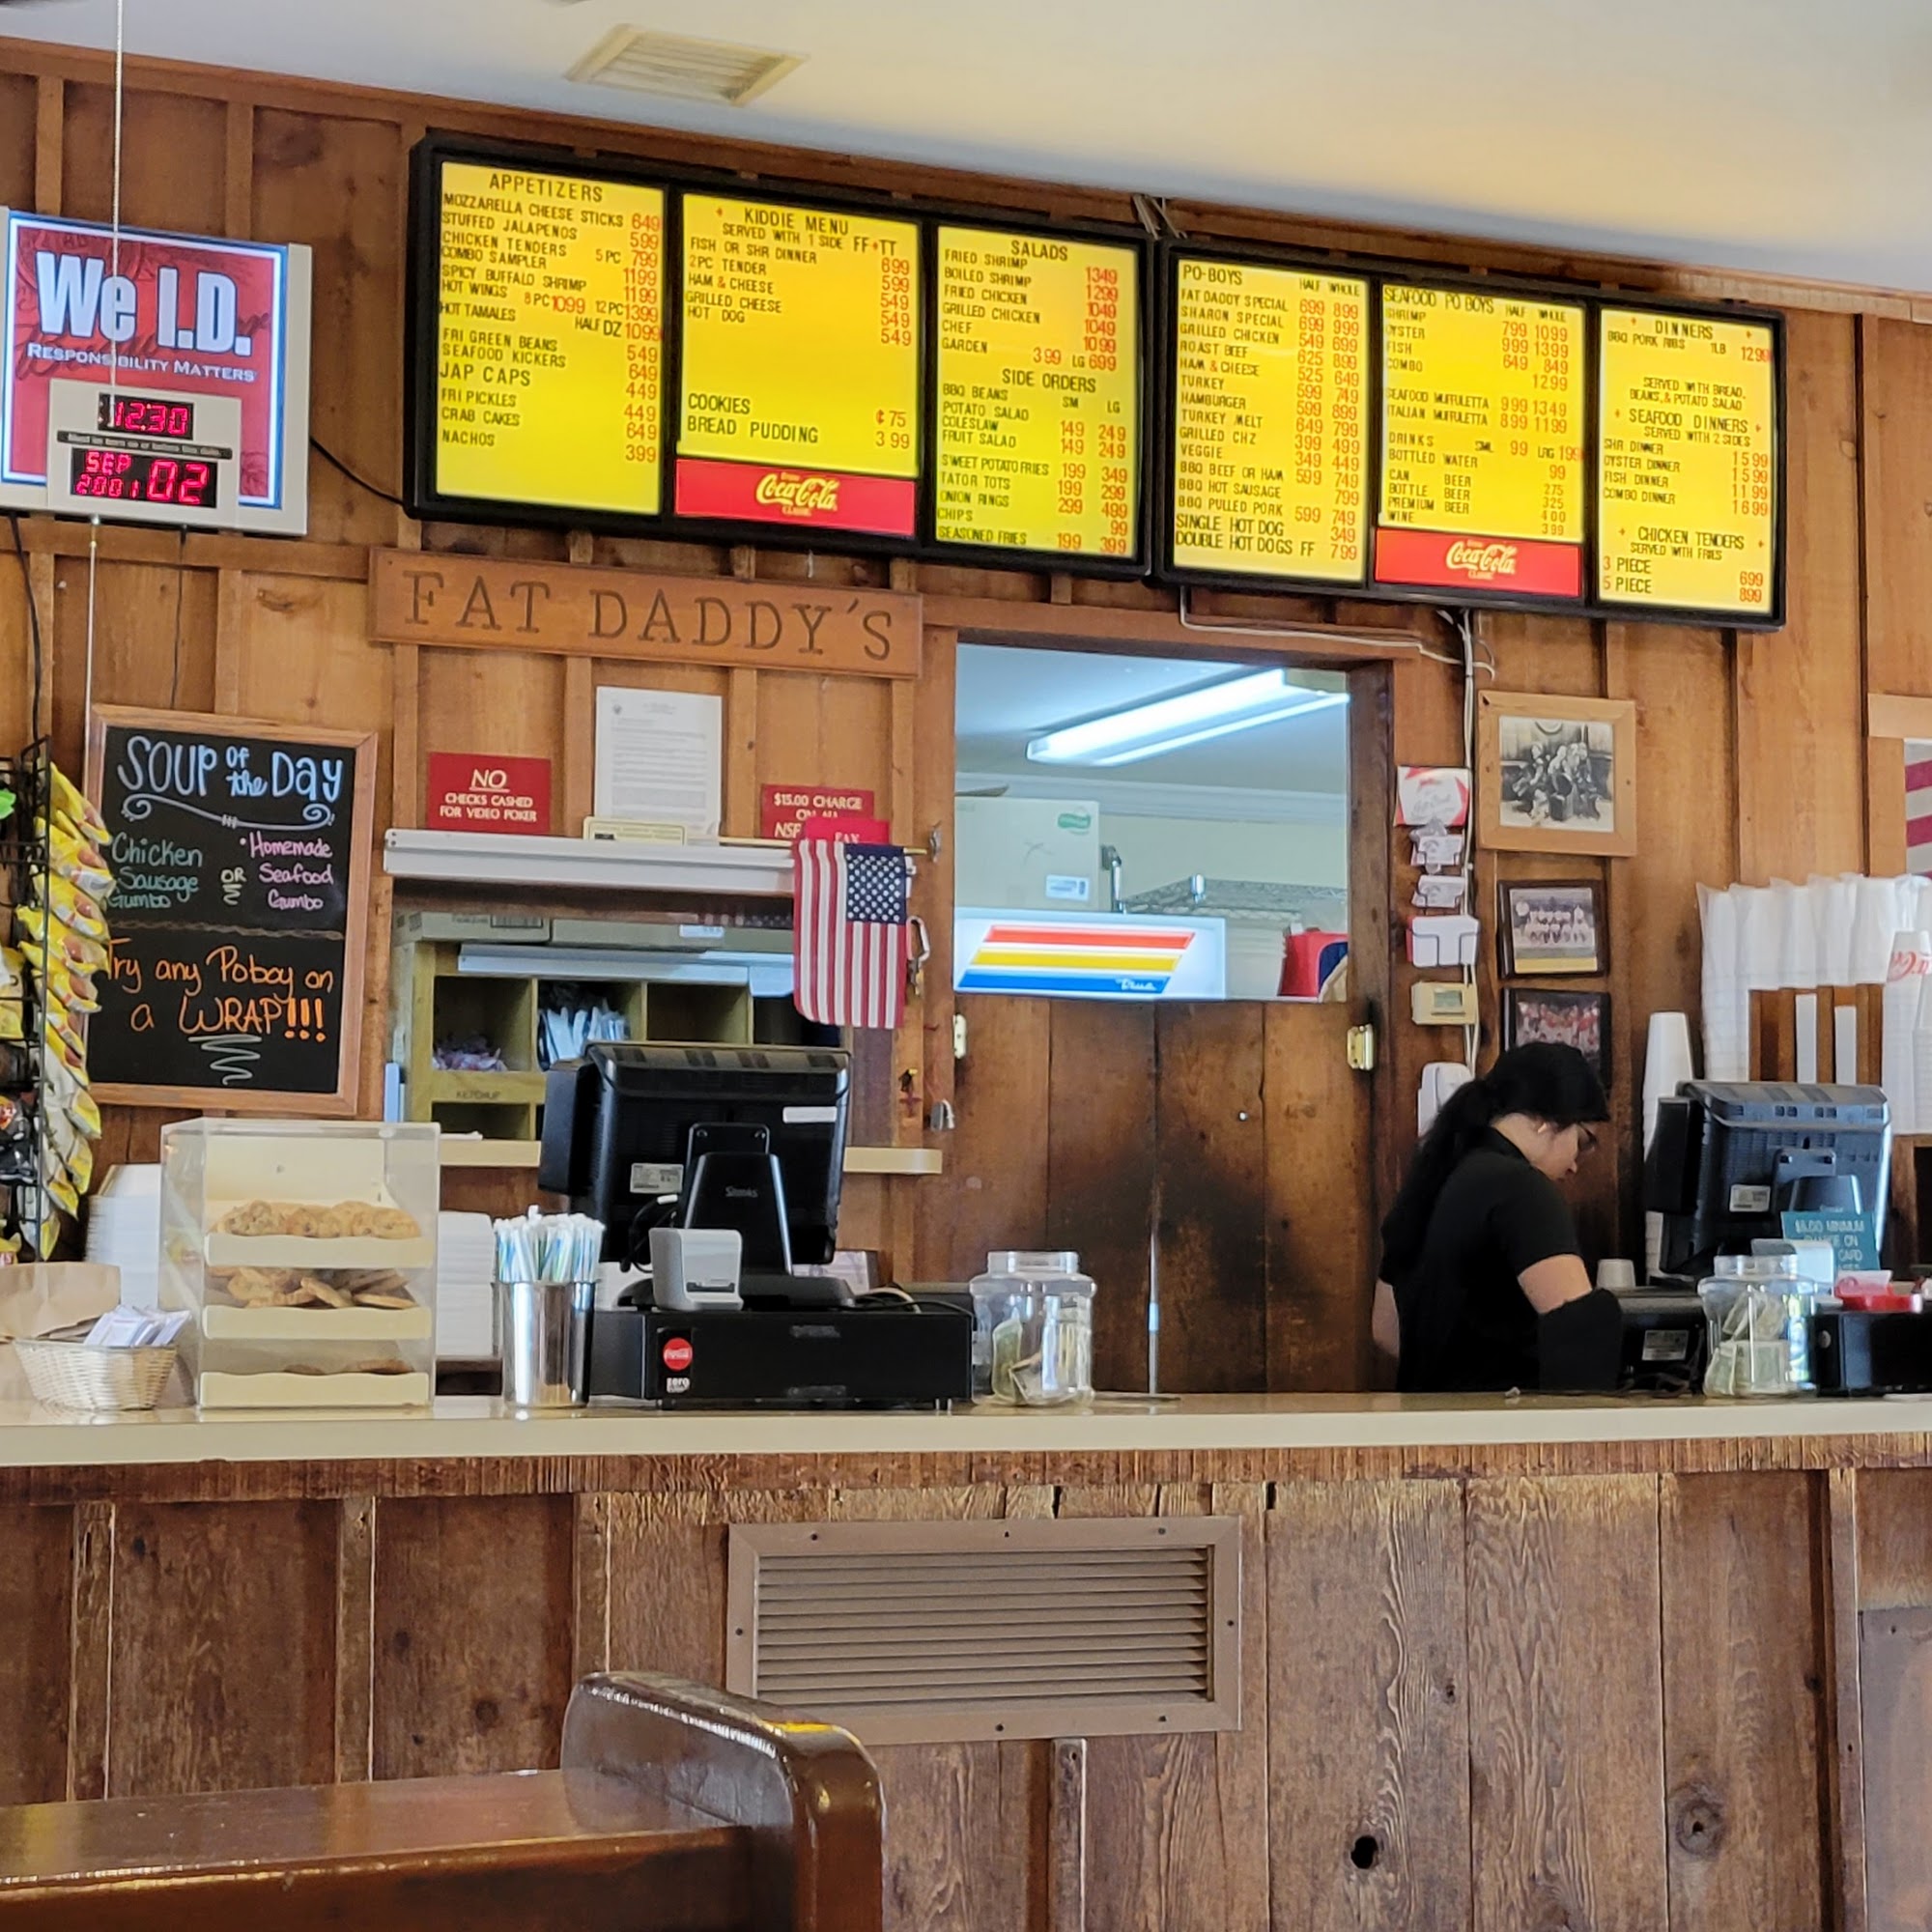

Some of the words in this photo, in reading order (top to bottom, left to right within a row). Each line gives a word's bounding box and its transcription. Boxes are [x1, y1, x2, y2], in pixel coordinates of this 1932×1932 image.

[490, 174, 603, 202] APPETIZERS
[442, 194, 522, 215] MOZZARELLA
[528, 204, 573, 221] CHEESE
[581, 211, 624, 227] STICKS
[632, 213, 660, 232] 649
[745, 208, 794, 229] KIDDIE
[806, 215, 848, 235] MENU
[442, 212, 495, 229] STUFFED
[503, 220, 578, 240] JALAPENOS
[630, 232, 659, 249] 599
[723, 223, 765, 240] SERVED
[773, 230, 800, 243] WITH
[819, 235, 842, 249] SIDE
[442, 231, 497, 248] CHICKEN
[507, 238, 567, 257] TENDERS
[691, 237, 716, 252] FISH
[776, 246, 816, 264] DINNER
[1011, 241, 1067, 261] SALADS
[442, 245, 482, 262] COMBO
[490, 252, 546, 270] SAMPLER
[945, 249, 977, 264] FRIED
[984, 254, 1028, 270] SHRIMP
[442, 265, 475, 279] SPICY
[486, 269, 534, 285] BUFFALO
[543, 276, 586, 292] SHRIMP
[688, 273, 713, 287] HAM
[729, 278, 774, 295] CHEESE
[723, 259, 766, 274] TENDER
[882, 275, 909, 293] 599
[945, 268, 983, 283] BOILED
[989, 272, 1032, 288] SHRIMP
[1183, 265, 1242, 285] PO-BOYS
[442, 279, 463, 294] HOT
[469, 283, 507, 298] WINGS
[36, 250, 137, 343] We
[156, 266, 252, 356] I.D.
[440, 300, 462, 316] HOT
[465, 303, 515, 321] TAMALES
[685, 291, 732, 307] GRILLED
[740, 297, 781, 314] CHEESE
[943, 302, 985, 318] GRILLED
[992, 307, 1040, 324] CHICKEN
[1181, 289, 1201, 300] FAT
[1204, 292, 1240, 305] DADDY
[1244, 296, 1289, 312] SPECIAL
[1299, 299, 1324, 315] 699
[688, 306, 709, 320] HOT
[722, 309, 745, 324] DOG
[881, 328, 911, 346] 549
[942, 320, 973, 334] CHEF
[1181, 306, 1229, 321] SHARON
[1236, 312, 1284, 327] SPECIAL
[469, 330, 511, 347] GREEN
[520, 336, 557, 352] BEANS
[1656, 320, 1714, 340] DINNERS
[442, 343, 503, 361] SEAFOOD
[513, 352, 566, 368] KICKERS
[942, 337, 987, 354] GARDEN
[1180, 340, 1220, 354] ROAST
[1225, 345, 1248, 357] BEEF
[1298, 350, 1323, 366] 625
[26, 342, 170, 372] RESPONSBILITY
[440, 362, 473, 380] JAP
[483, 366, 531, 386] CAPS
[1003, 368, 1035, 385] SIDE
[1042, 373, 1095, 392] ORDERS
[1181, 375, 1224, 389] TURKEY
[689, 393, 750, 414] COOKIES
[943, 401, 985, 417] POTATO
[994, 407, 1029, 421] SALAD
[1181, 392, 1245, 410] HAMBURGER
[441, 407, 475, 422] CRAB
[484, 411, 520, 426] CAKES
[942, 415, 999, 431] COLESLAW
[1630, 409, 1682, 426] SEAFOOD
[1693, 415, 1748, 434] DINNERS
[688, 415, 737, 435] BREAD
[750, 421, 818, 444] PUDDING
[942, 430, 974, 444] FRUIT
[980, 433, 1016, 448] SALAD
[1389, 433, 1434, 446] DRINKS
[442, 429, 495, 446] NACHOS
[626, 444, 656, 463] 399
[1180, 444, 1222, 459] VEGGIE
[1295, 452, 1321, 468] 349
[86, 451, 131, 475] SEP
[1389, 449, 1435, 464] BOTTLED
[1443, 454, 1478, 469] WATER
[147, 460, 210, 505] 02
[942, 472, 978, 487] TATOR
[984, 475, 1010, 490] TOTS
[1063, 463, 1086, 479] 199
[1102, 467, 1127, 484] 349
[1389, 469, 1409, 481] CAN
[1444, 474, 1471, 487] BEER
[1605, 471, 1626, 483] FISH
[1389, 483, 1428, 497] BOTTLE
[1444, 488, 1470, 500] BEER
[937, 508, 973, 522] CHIPS
[1388, 497, 1435, 511] PREMIUM
[1445, 502, 1469, 514] BEER
[1176, 513, 1221, 530] SINGLE
[1231, 518, 1254, 533] HOT
[1258, 520, 1284, 536] DOG
[1388, 511, 1414, 523] WINE
[1176, 531, 1223, 549] DOUBLE
[1230, 535, 1254, 552] HOT
[1257, 538, 1293, 554] DOGS
[1638, 526, 1688, 545] CHICKEN
[1695, 531, 1745, 550] TENDERS
[1617, 557, 1652, 574] PIECE
[1740, 571, 1763, 587] 699
[1616, 577, 1652, 593] PIECE
[402, 570, 550, 634] FAT
[587, 587, 893, 661] DADDY'S
[117, 736, 216, 796] SOUP
[225, 771, 268, 797] the
[471, 769, 507, 788] NO
[445, 792, 487, 806] CHECKS
[491, 795, 533, 808] CASHED
[774, 792, 810, 806] $15.00
[812, 795, 863, 810] CHARGE
[440, 806, 462, 817] FOR
[467, 807, 500, 820] VIDEO
[504, 809, 537, 822] POKER
[775, 822, 801, 838] NSF
[112, 832, 203, 867] Chicken
[249, 831, 332, 859] Homemade
[117, 867, 199, 902] Sausage
[259, 864, 333, 885] Seafood
[267, 889, 324, 910] Gumbo
[106, 937, 141, 993] Try
[155, 959, 203, 996] any
[206, 945, 294, 1003] Poboy
[305, 970, 333, 993] on
[129, 1003, 155, 1032] a
[178, 995, 327, 1042] WRAP!!!
